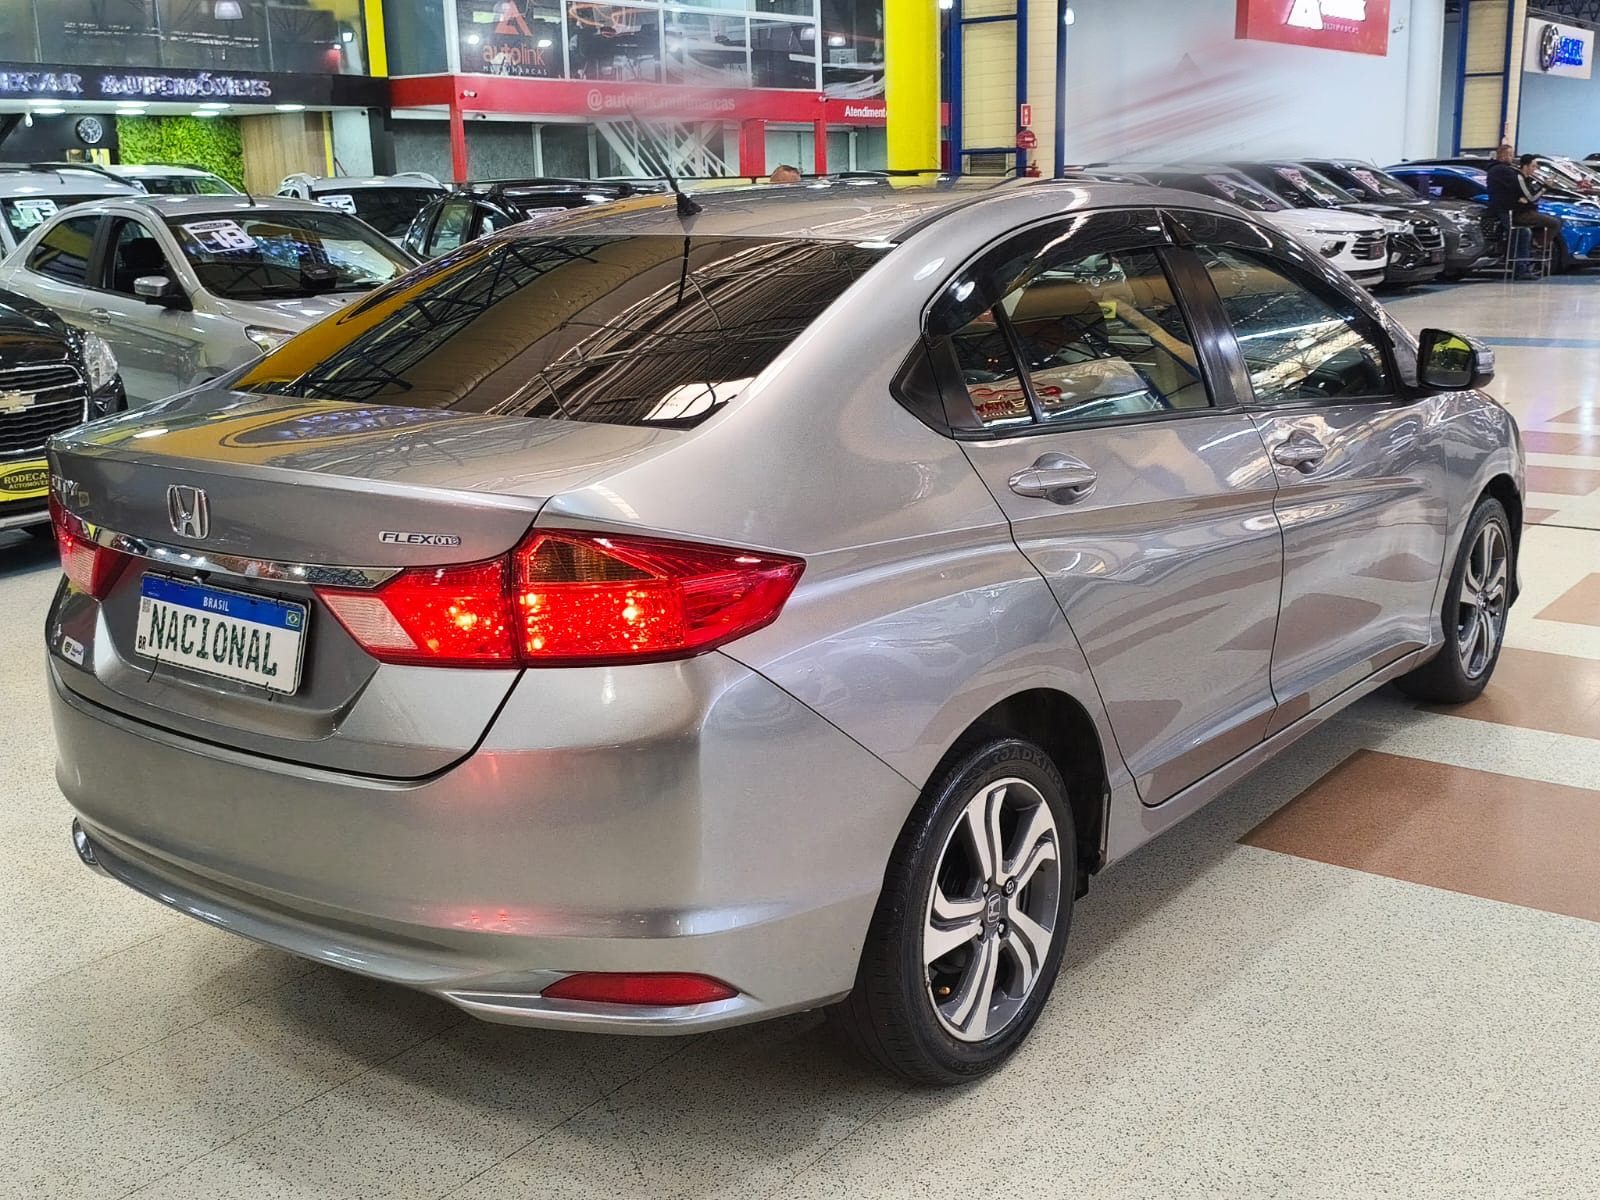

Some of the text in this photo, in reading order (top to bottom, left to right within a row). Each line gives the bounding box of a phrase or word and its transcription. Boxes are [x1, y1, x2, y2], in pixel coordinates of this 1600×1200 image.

[845, 105, 887, 118] Atendiment
[4, 471, 49, 485] RODECA
[203, 596, 230, 612] BRASIL
[138, 635, 147, 650] BR
[149, 603, 278, 677] NACIONAL
